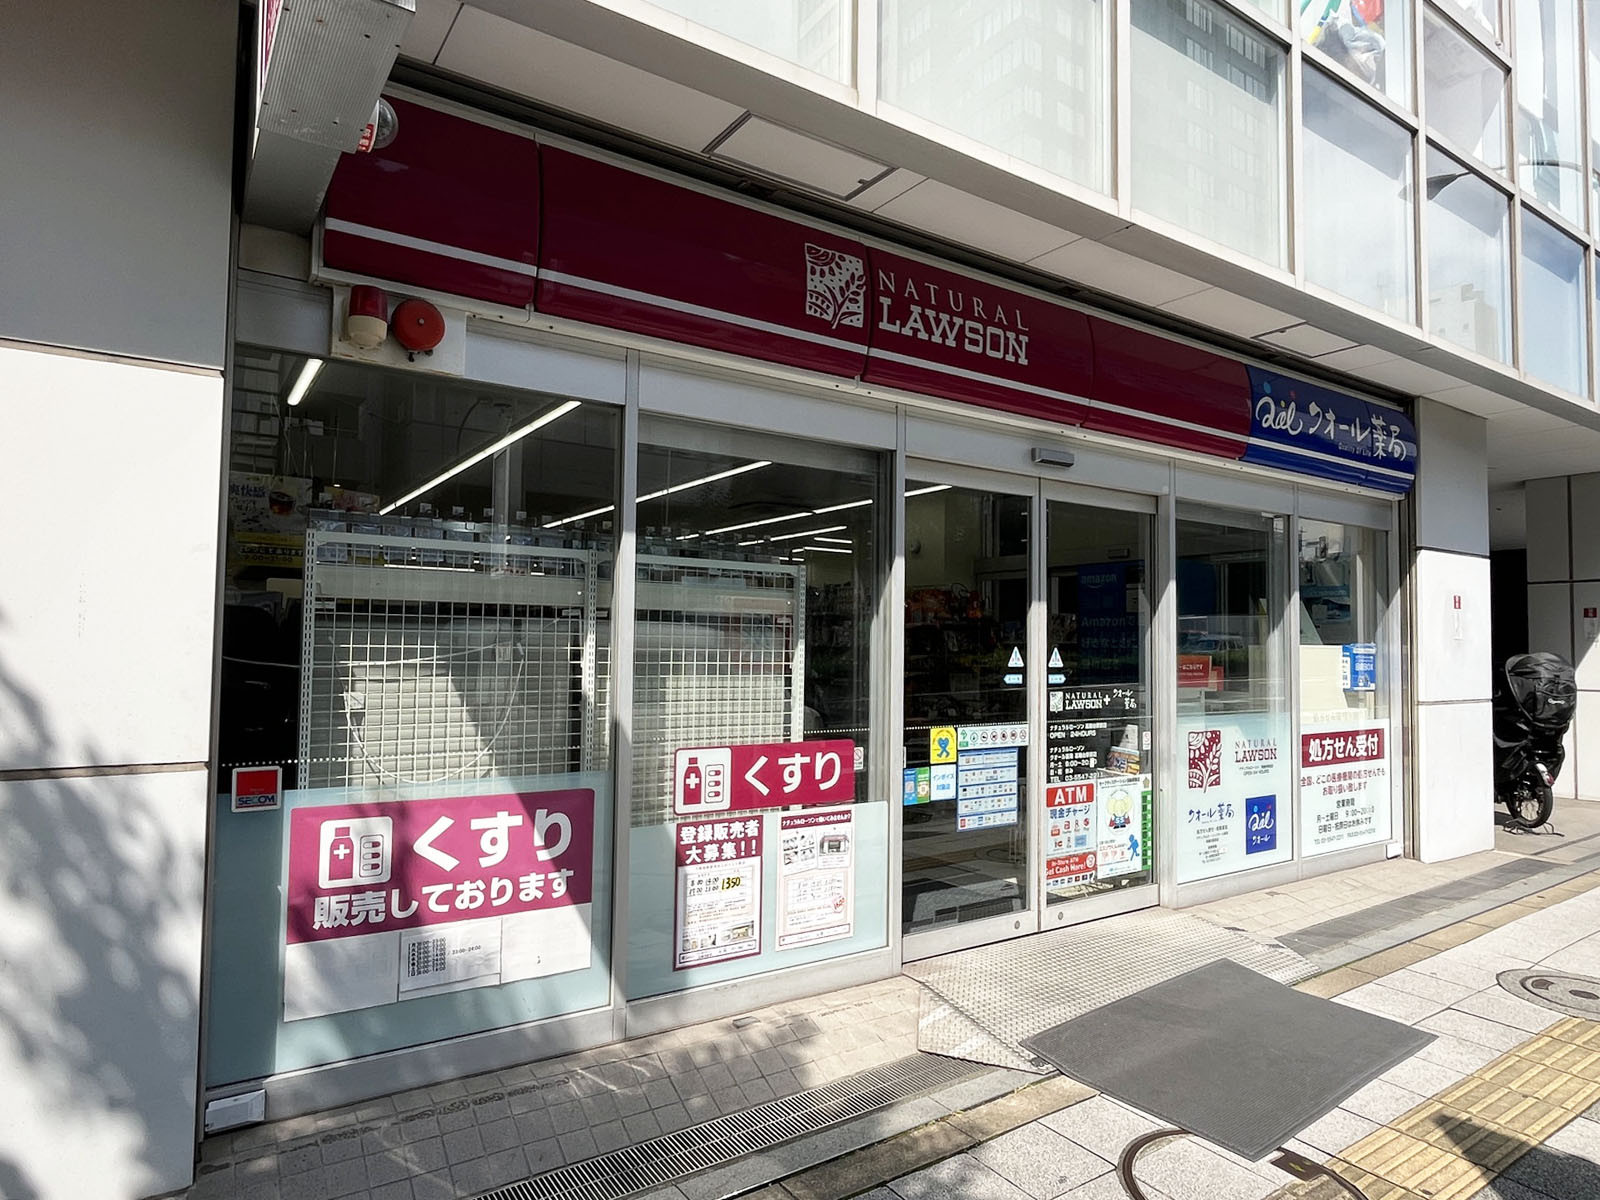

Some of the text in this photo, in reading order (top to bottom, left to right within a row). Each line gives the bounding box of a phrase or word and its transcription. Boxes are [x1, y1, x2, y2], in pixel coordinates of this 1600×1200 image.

[878, 269, 1029, 331] NATURAL
[878, 297, 1028, 365] LAWSON
[1065, 699, 1102, 710] LAWSON
[1235, 738, 1277, 749] NATURAL
[1308, 733, 1379, 762] 処方せん受付
[1235, 748, 1277, 763] LAWSON
[744, 751, 840, 796] くすり
[1054, 786, 1087, 805] ATM
[1050, 804, 1090, 819] 現金チャージ
[412, 808, 573, 872] くすり
[679, 819, 760, 845] 登録販売者
[1252, 834, 1271, 845] クオール
[1055, 865, 1069, 874] Cash
[312, 869, 575, 930] 販売しております
